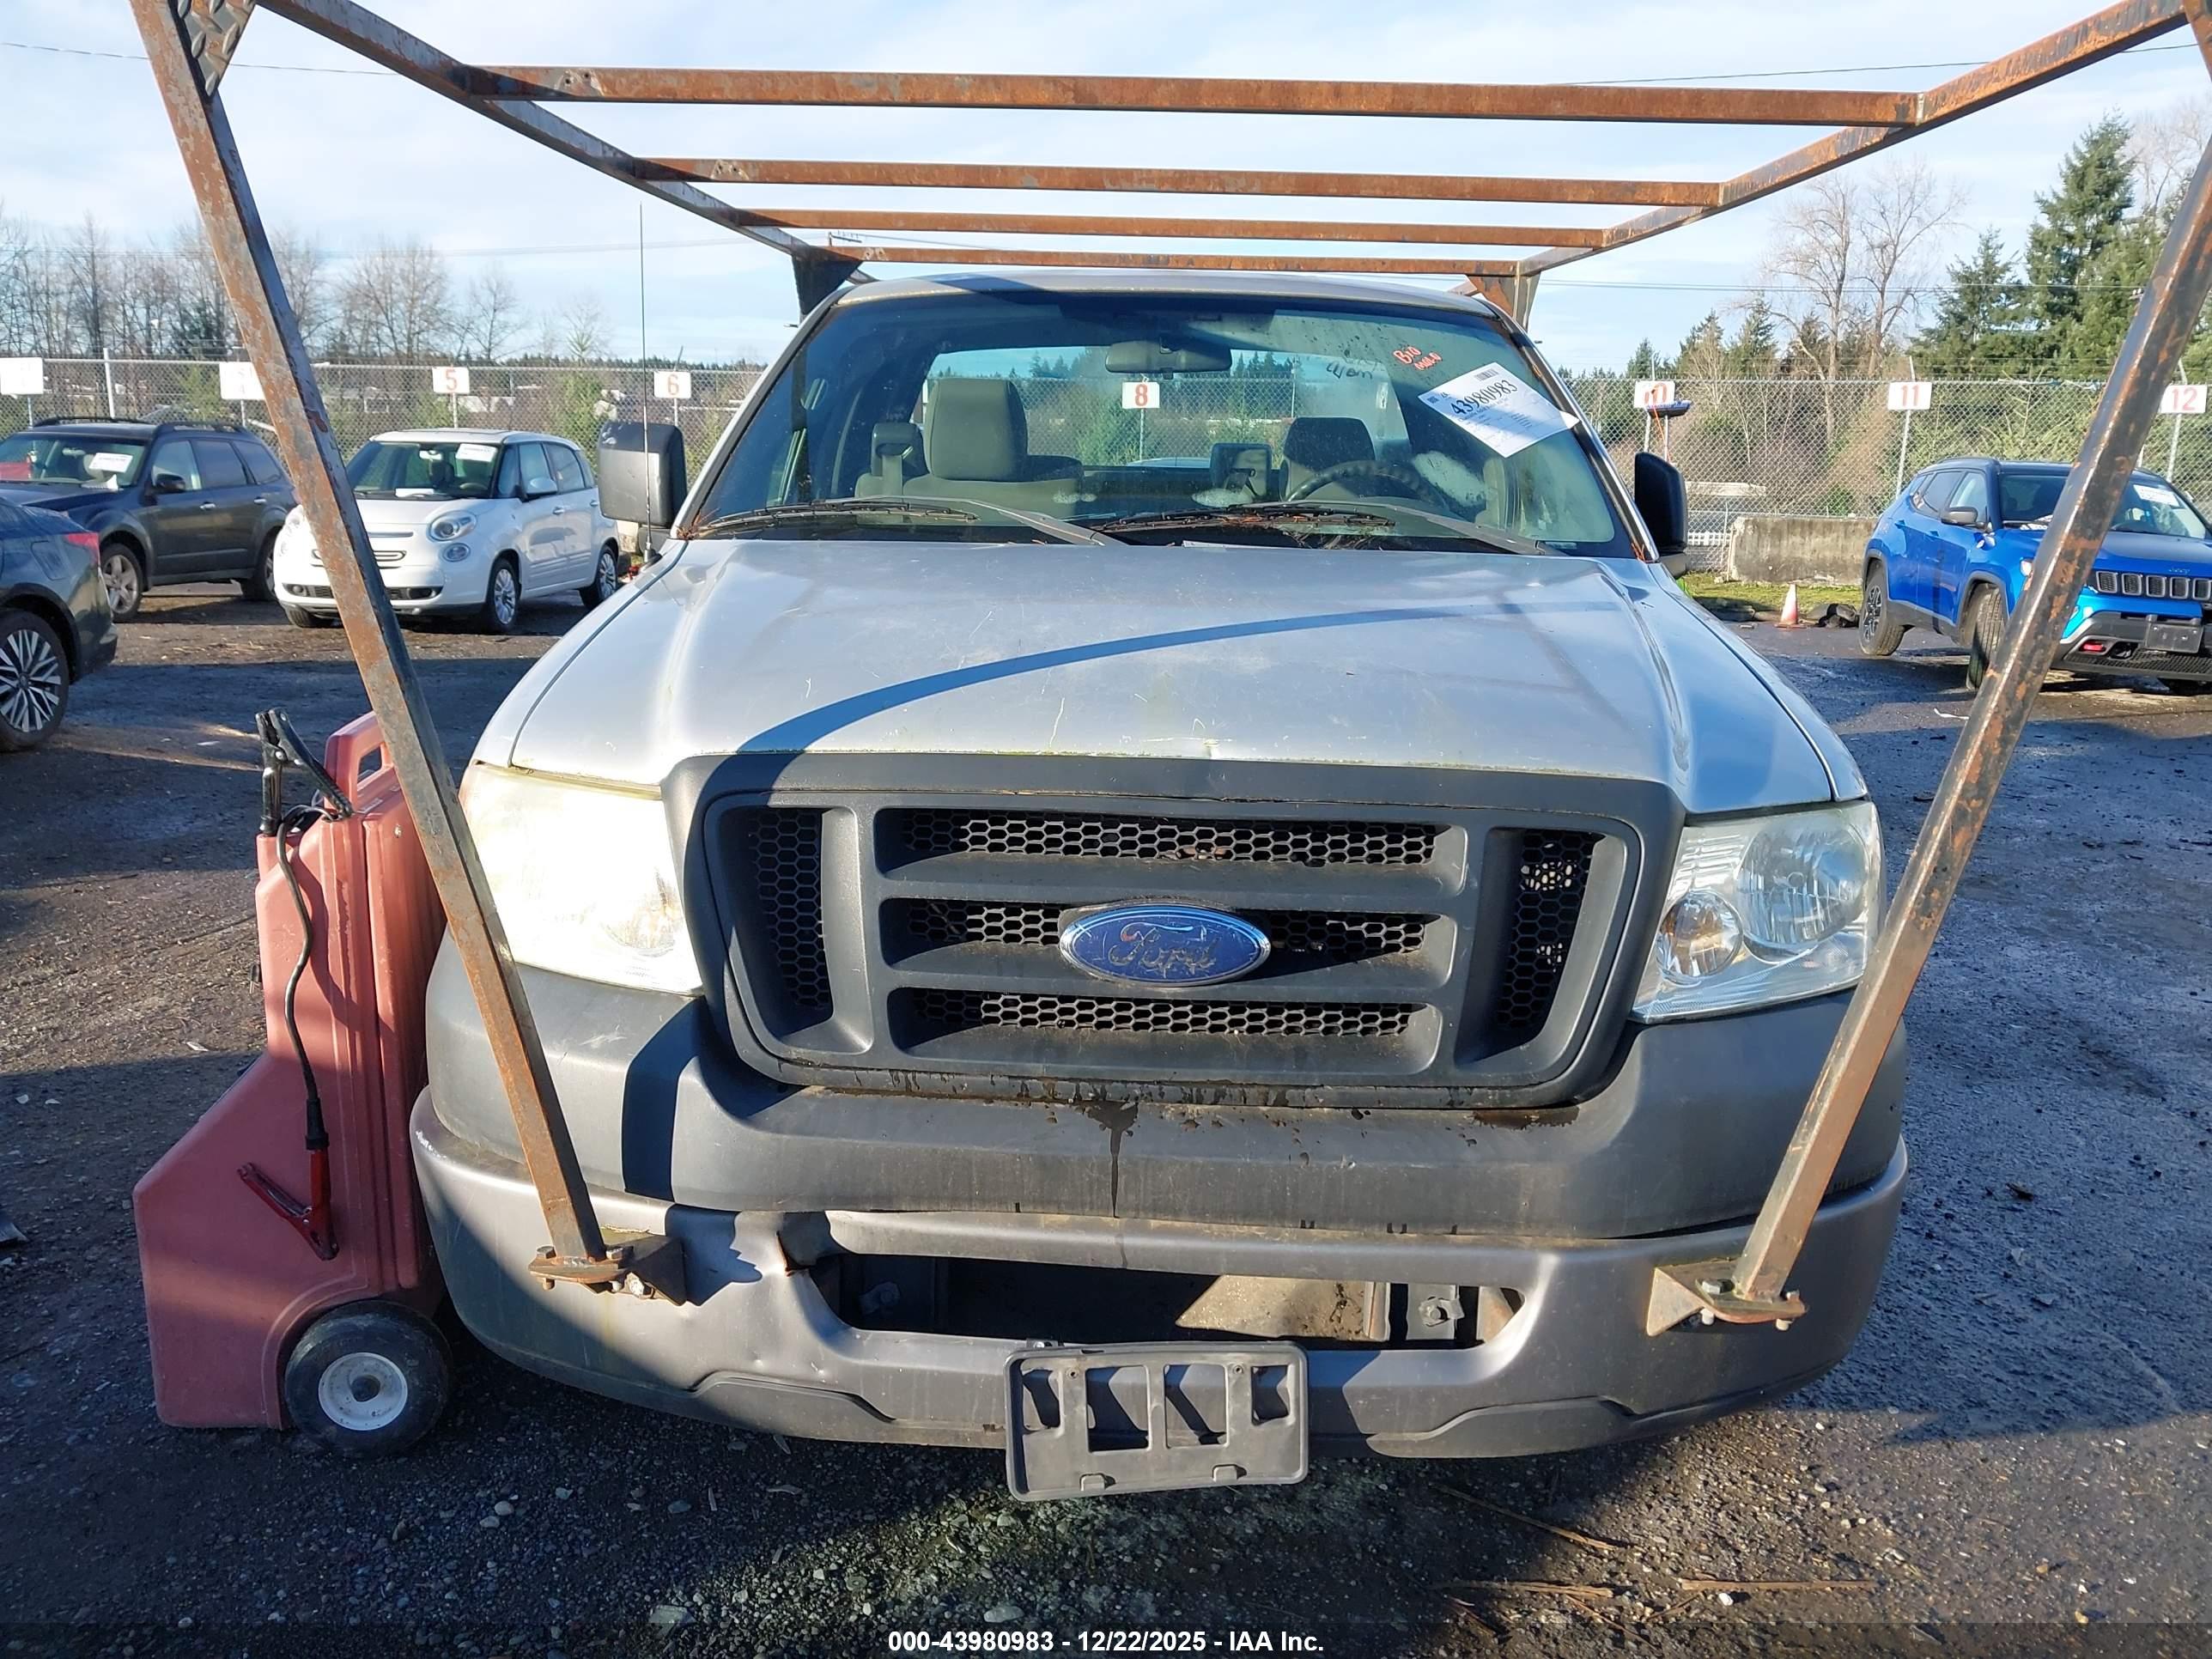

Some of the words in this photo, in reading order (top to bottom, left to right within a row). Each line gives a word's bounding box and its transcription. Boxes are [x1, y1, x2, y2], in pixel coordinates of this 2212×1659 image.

[445, 368, 458, 392] 5
[667, 374, 680, 396] 6
[1134, 383, 1149, 407] 8
[1449, 379, 1518, 416] 43980983
[1900, 385, 1920, 408] 11
[2172, 386, 2198, 411] 12
[1107, 921, 1218, 976] Ford
